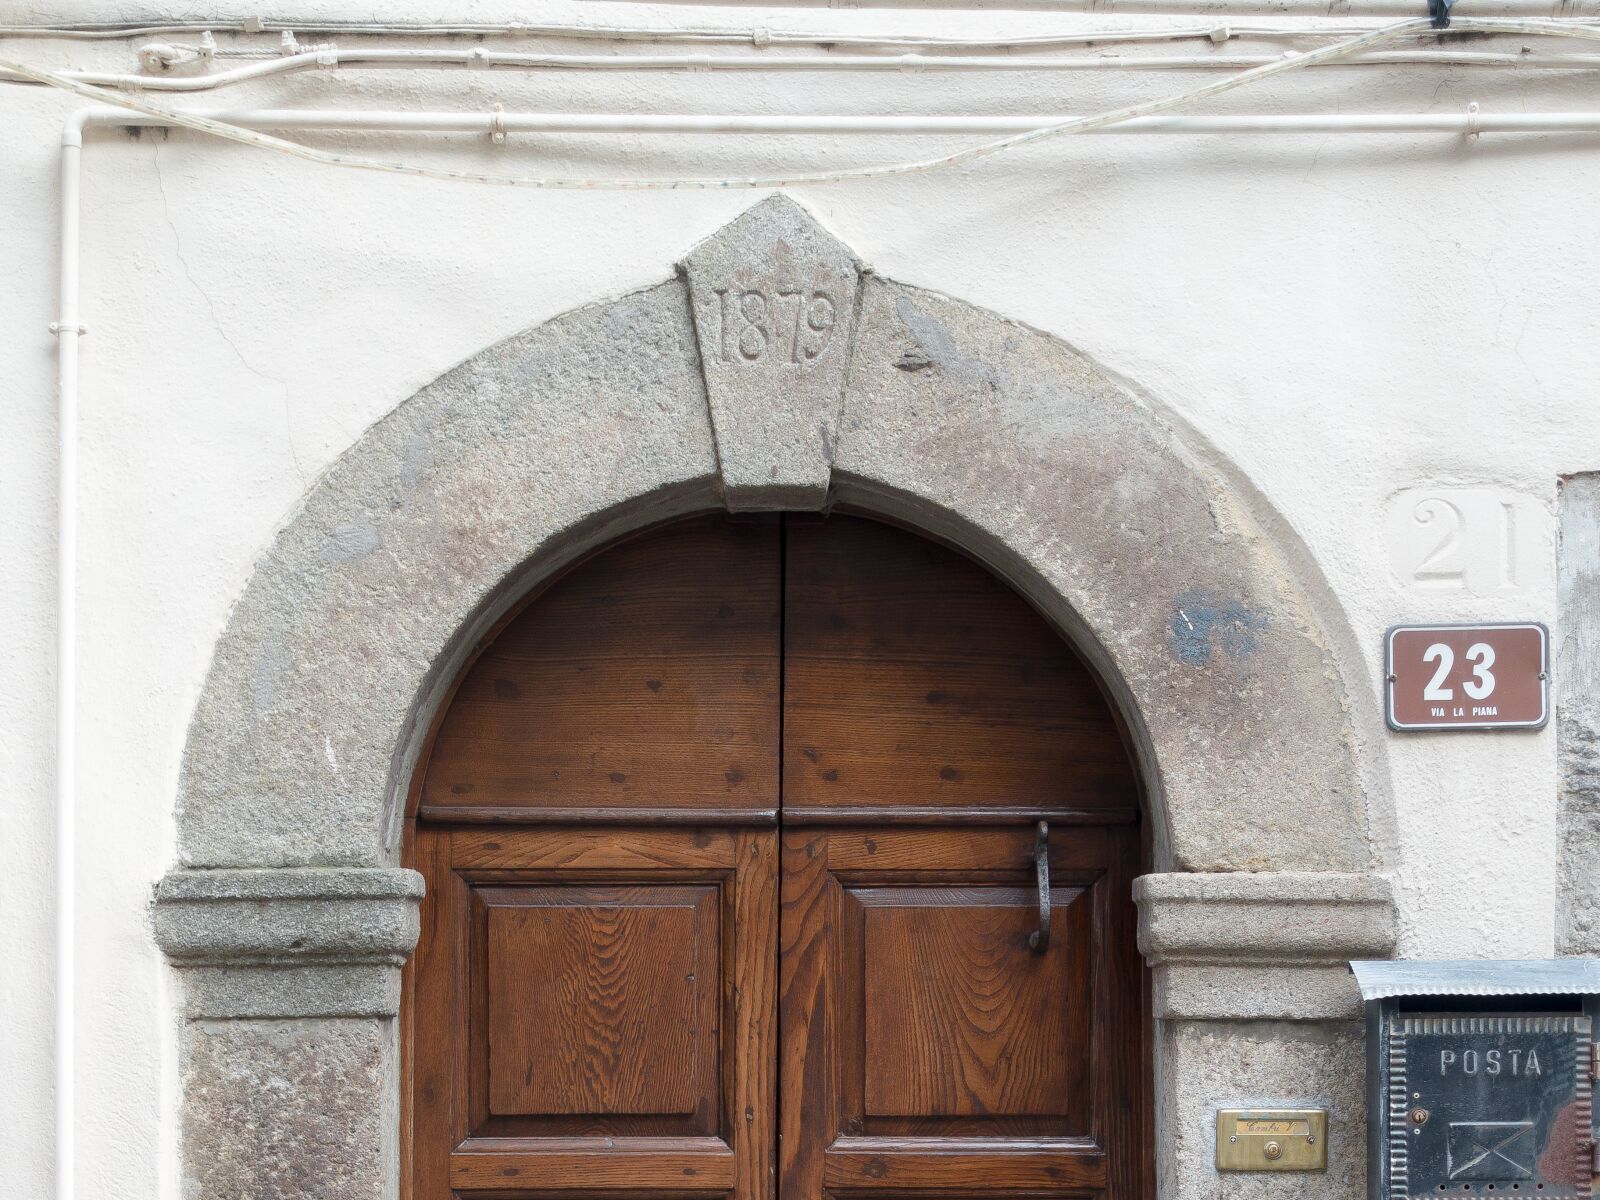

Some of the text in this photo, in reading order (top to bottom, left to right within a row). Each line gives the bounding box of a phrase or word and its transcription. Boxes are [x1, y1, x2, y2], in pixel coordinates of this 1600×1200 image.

[713, 289, 835, 363] 1879
[1414, 498, 1519, 588] 21
[1423, 643, 1495, 700] 23
[1431, 706, 1497, 716] VIA LA PIANA
[1440, 1050, 1541, 1076] POSTA
